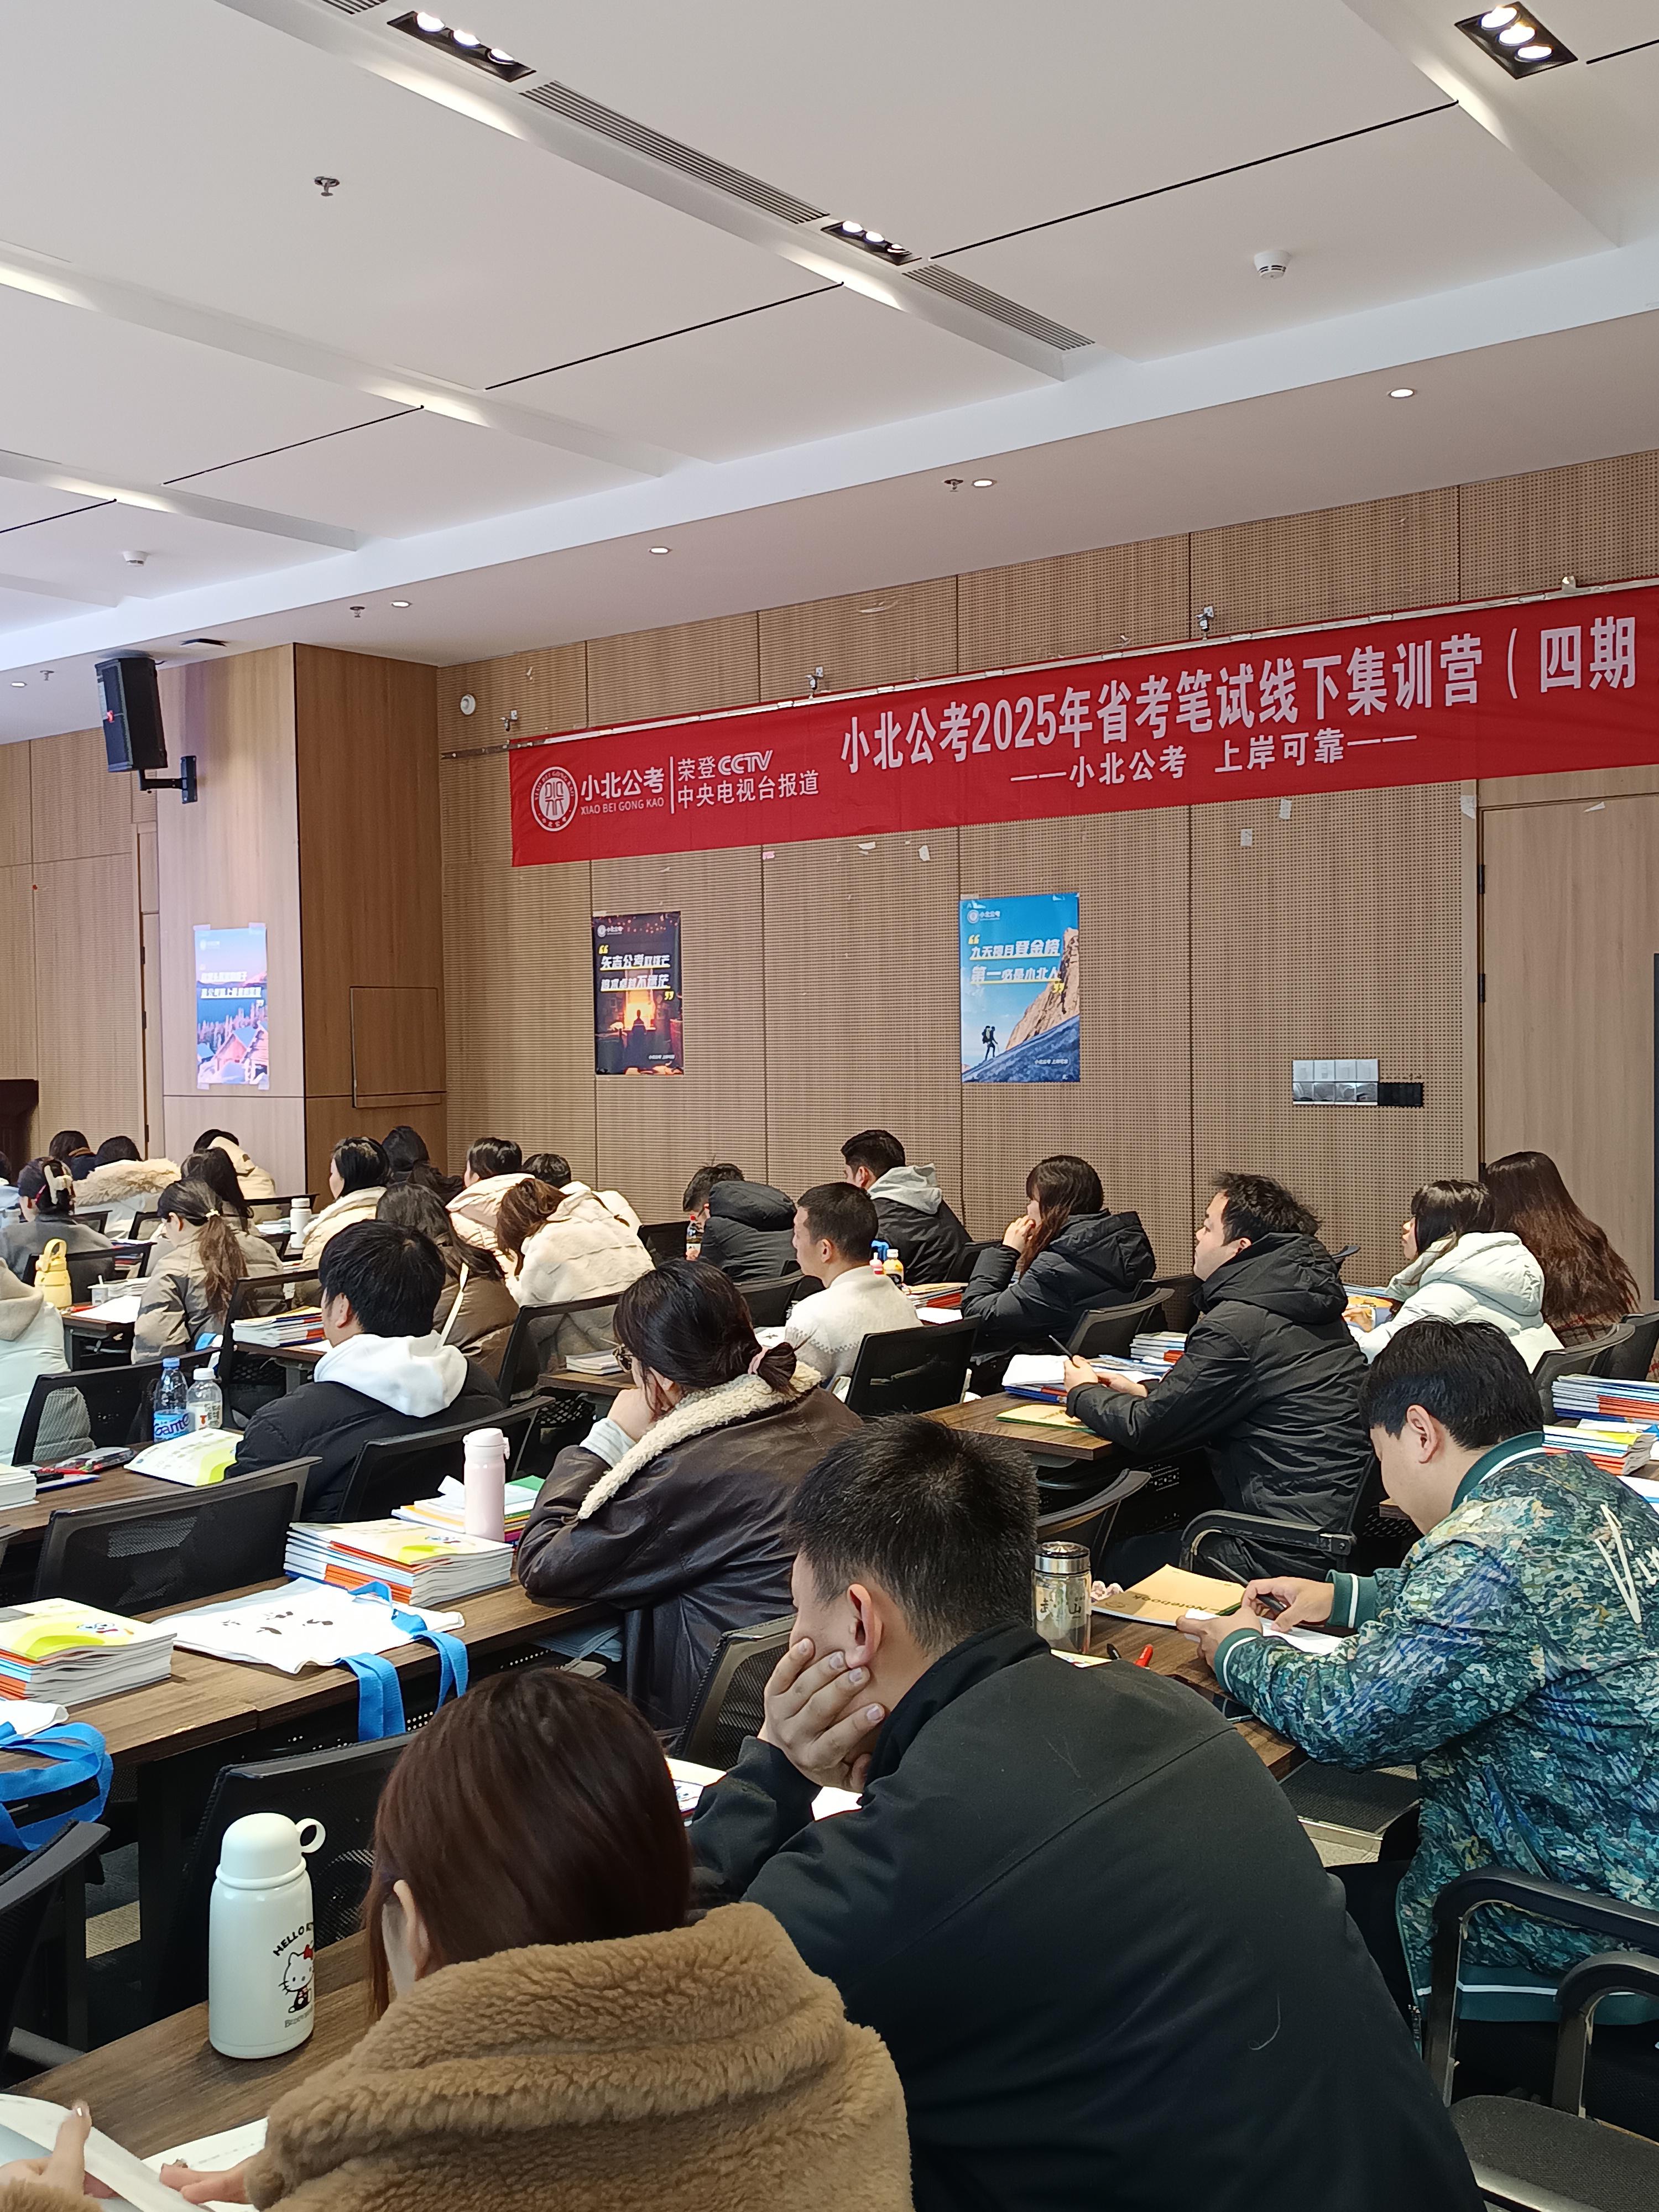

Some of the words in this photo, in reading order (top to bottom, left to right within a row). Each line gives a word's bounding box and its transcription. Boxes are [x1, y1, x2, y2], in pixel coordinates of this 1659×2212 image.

[581, 766, 664, 801] 小北公考
[677, 770, 819, 810] 中央电视台报道
[581, 804, 601, 816] XIAO
[602, 802, 617, 813] BEI
[618, 800, 644, 811] GONG
[646, 797, 664, 809] KAO
[1133, 1594, 1208, 1611] Notebook
[273, 1926, 305, 1957] HELLO
